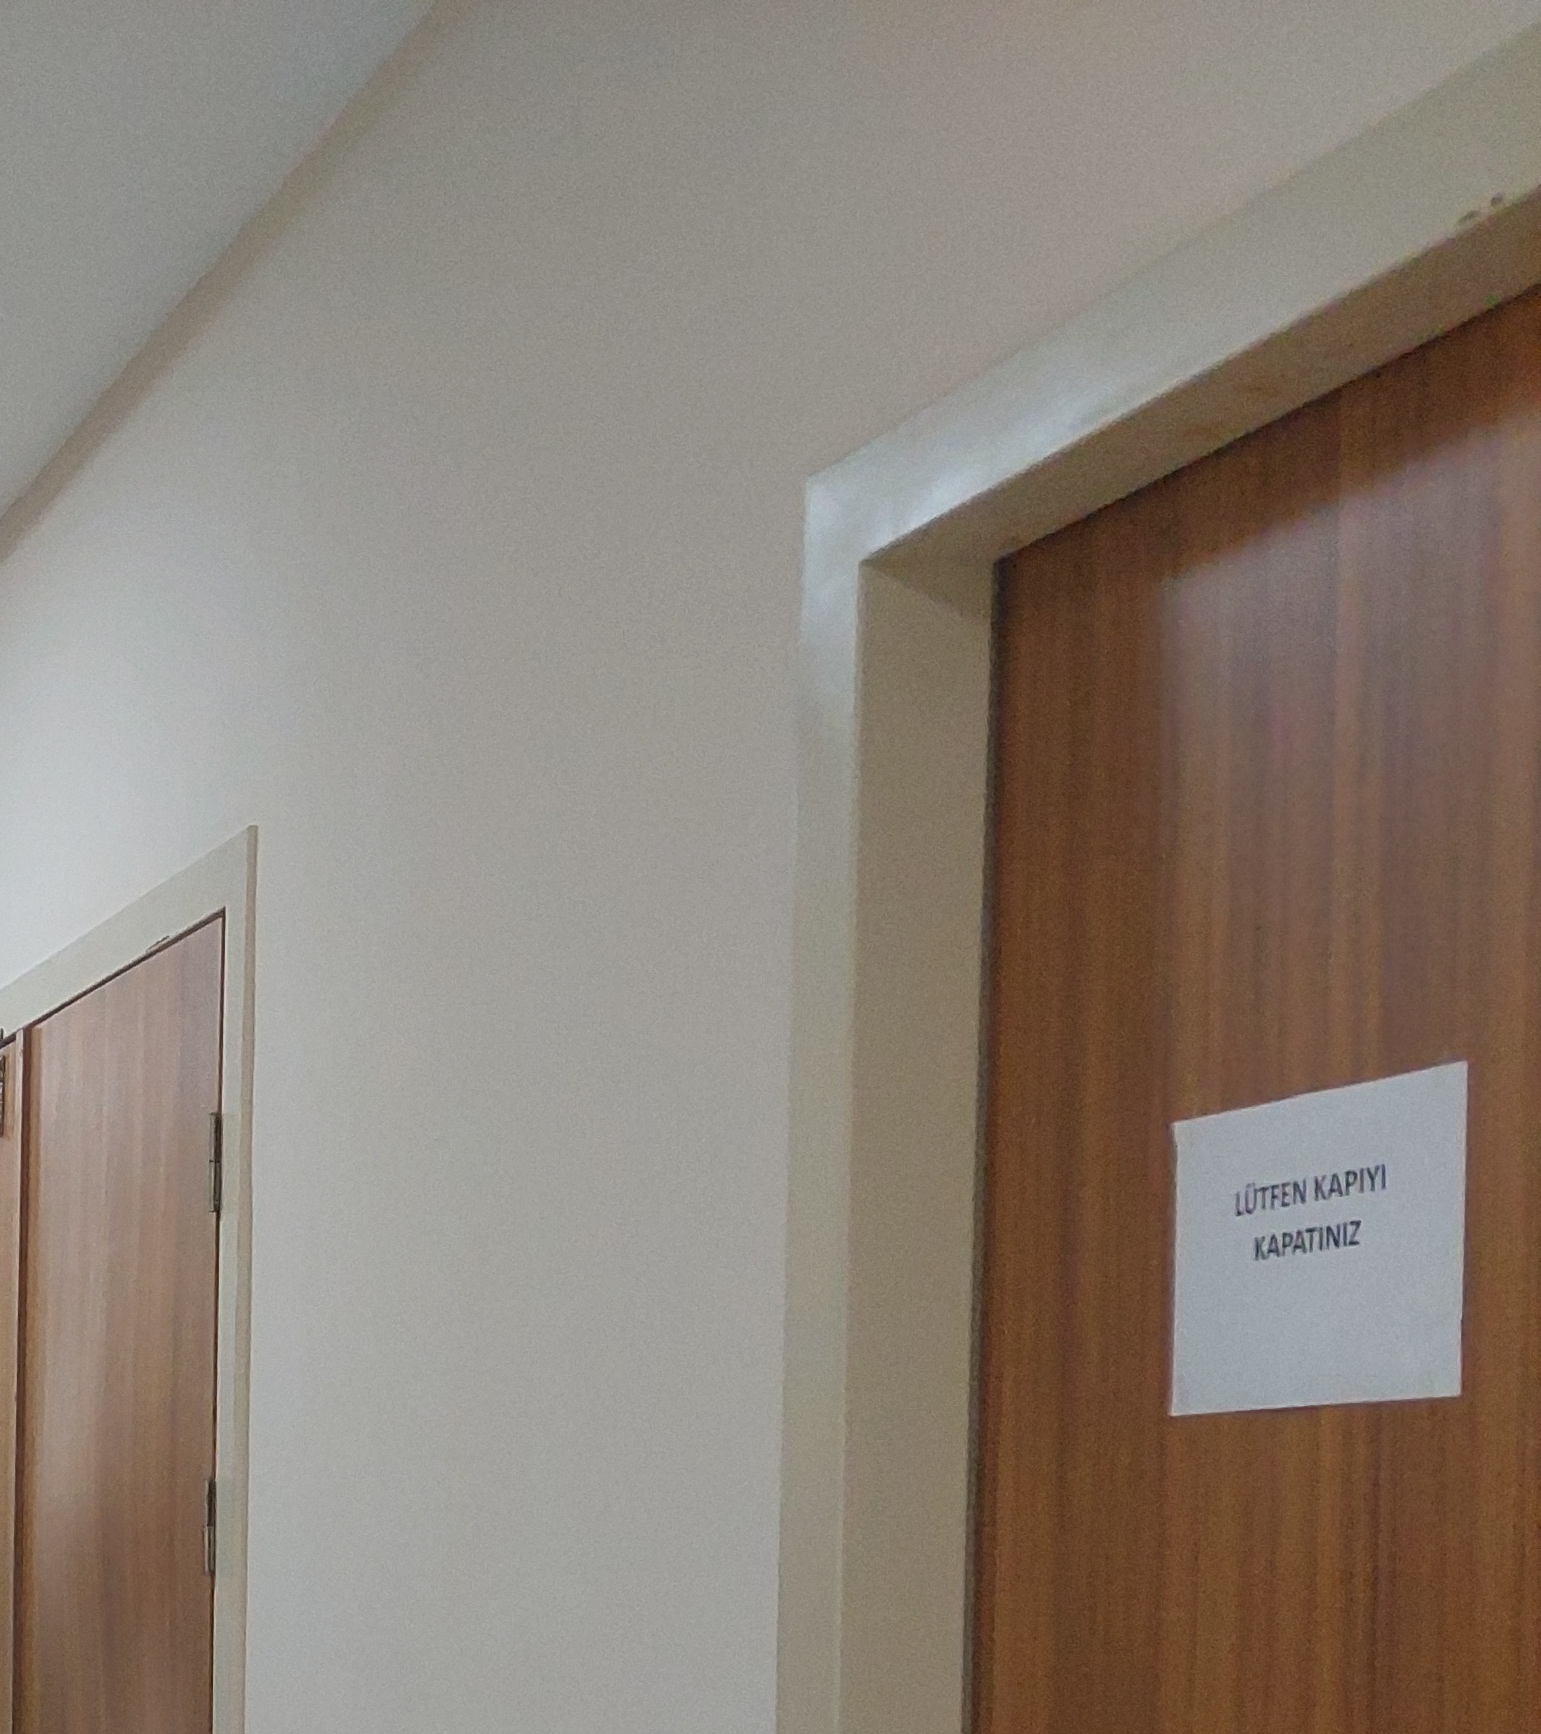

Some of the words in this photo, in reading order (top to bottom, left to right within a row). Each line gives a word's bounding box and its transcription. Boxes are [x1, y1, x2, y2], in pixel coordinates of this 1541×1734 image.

[1234, 1176, 1307, 1217] LÜTFEN
[1314, 1163, 1387, 1202] KAPIYI
[1254, 1220, 1362, 1261] KAPATINIZ
